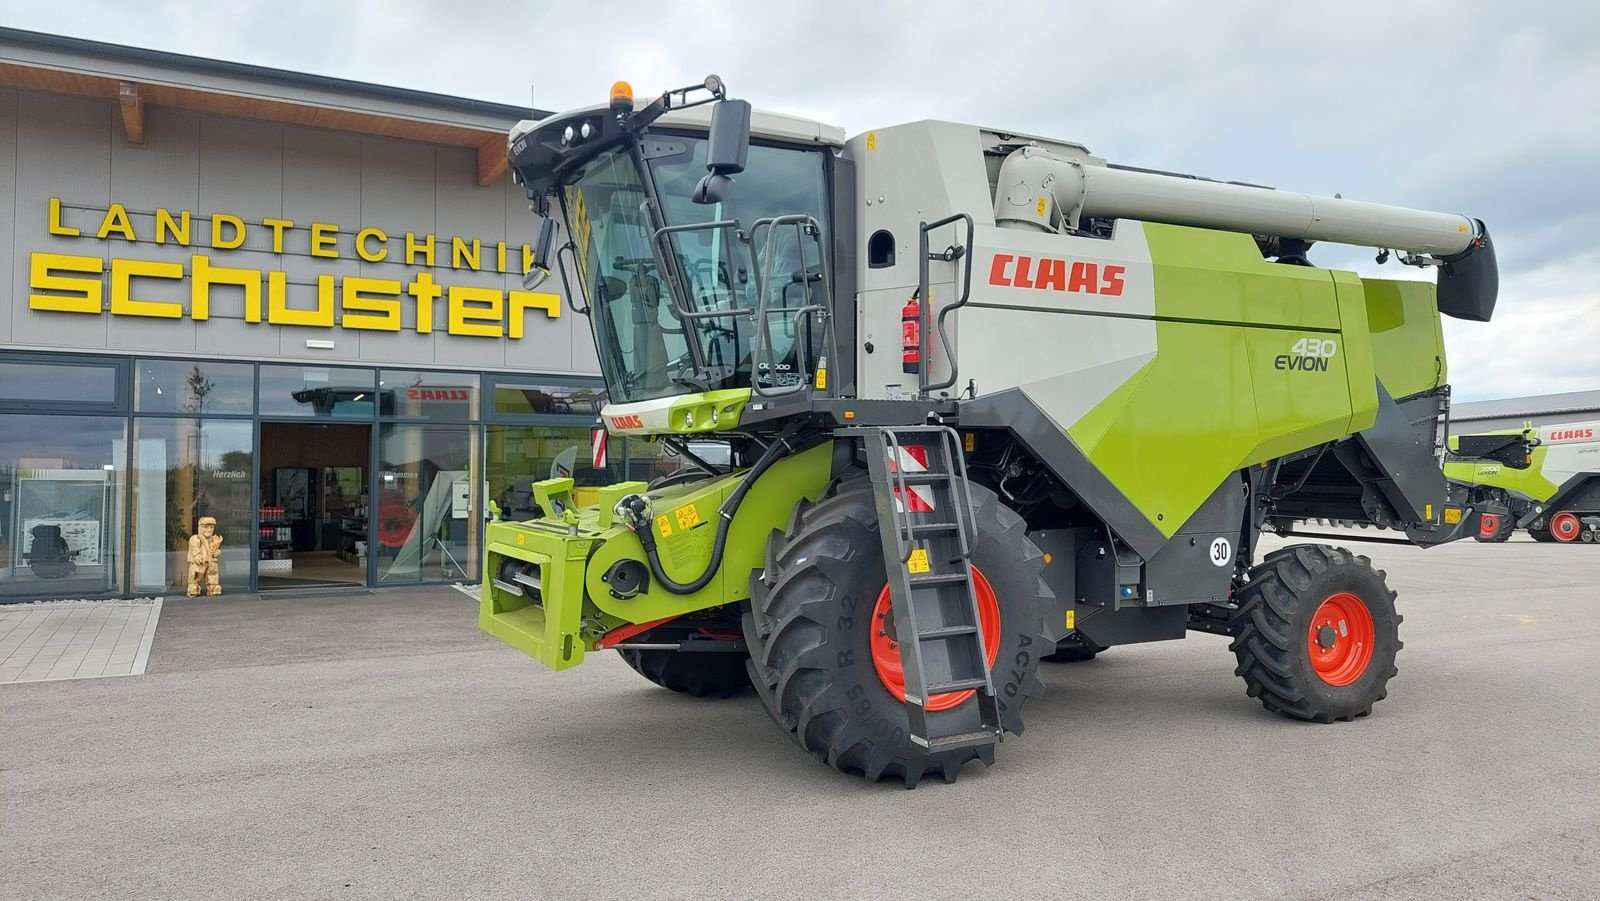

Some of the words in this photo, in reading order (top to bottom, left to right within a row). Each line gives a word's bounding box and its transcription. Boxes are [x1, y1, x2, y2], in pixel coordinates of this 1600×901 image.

[989, 253, 1126, 297] CLAAS
[1291, 337, 1338, 358] 430
[1274, 354, 1329, 373] EVION
[611, 415, 644, 430] CLAAS
[1550, 428, 1594, 441] CLAAS
[212, 470, 246, 479] Herzlich
[1213, 542, 1228, 561] 30
[836, 595, 858, 632] 32
[836, 650, 855, 670] R
[1004, 633, 1033, 698] AC70
[847, 682, 905, 744] 00/65
